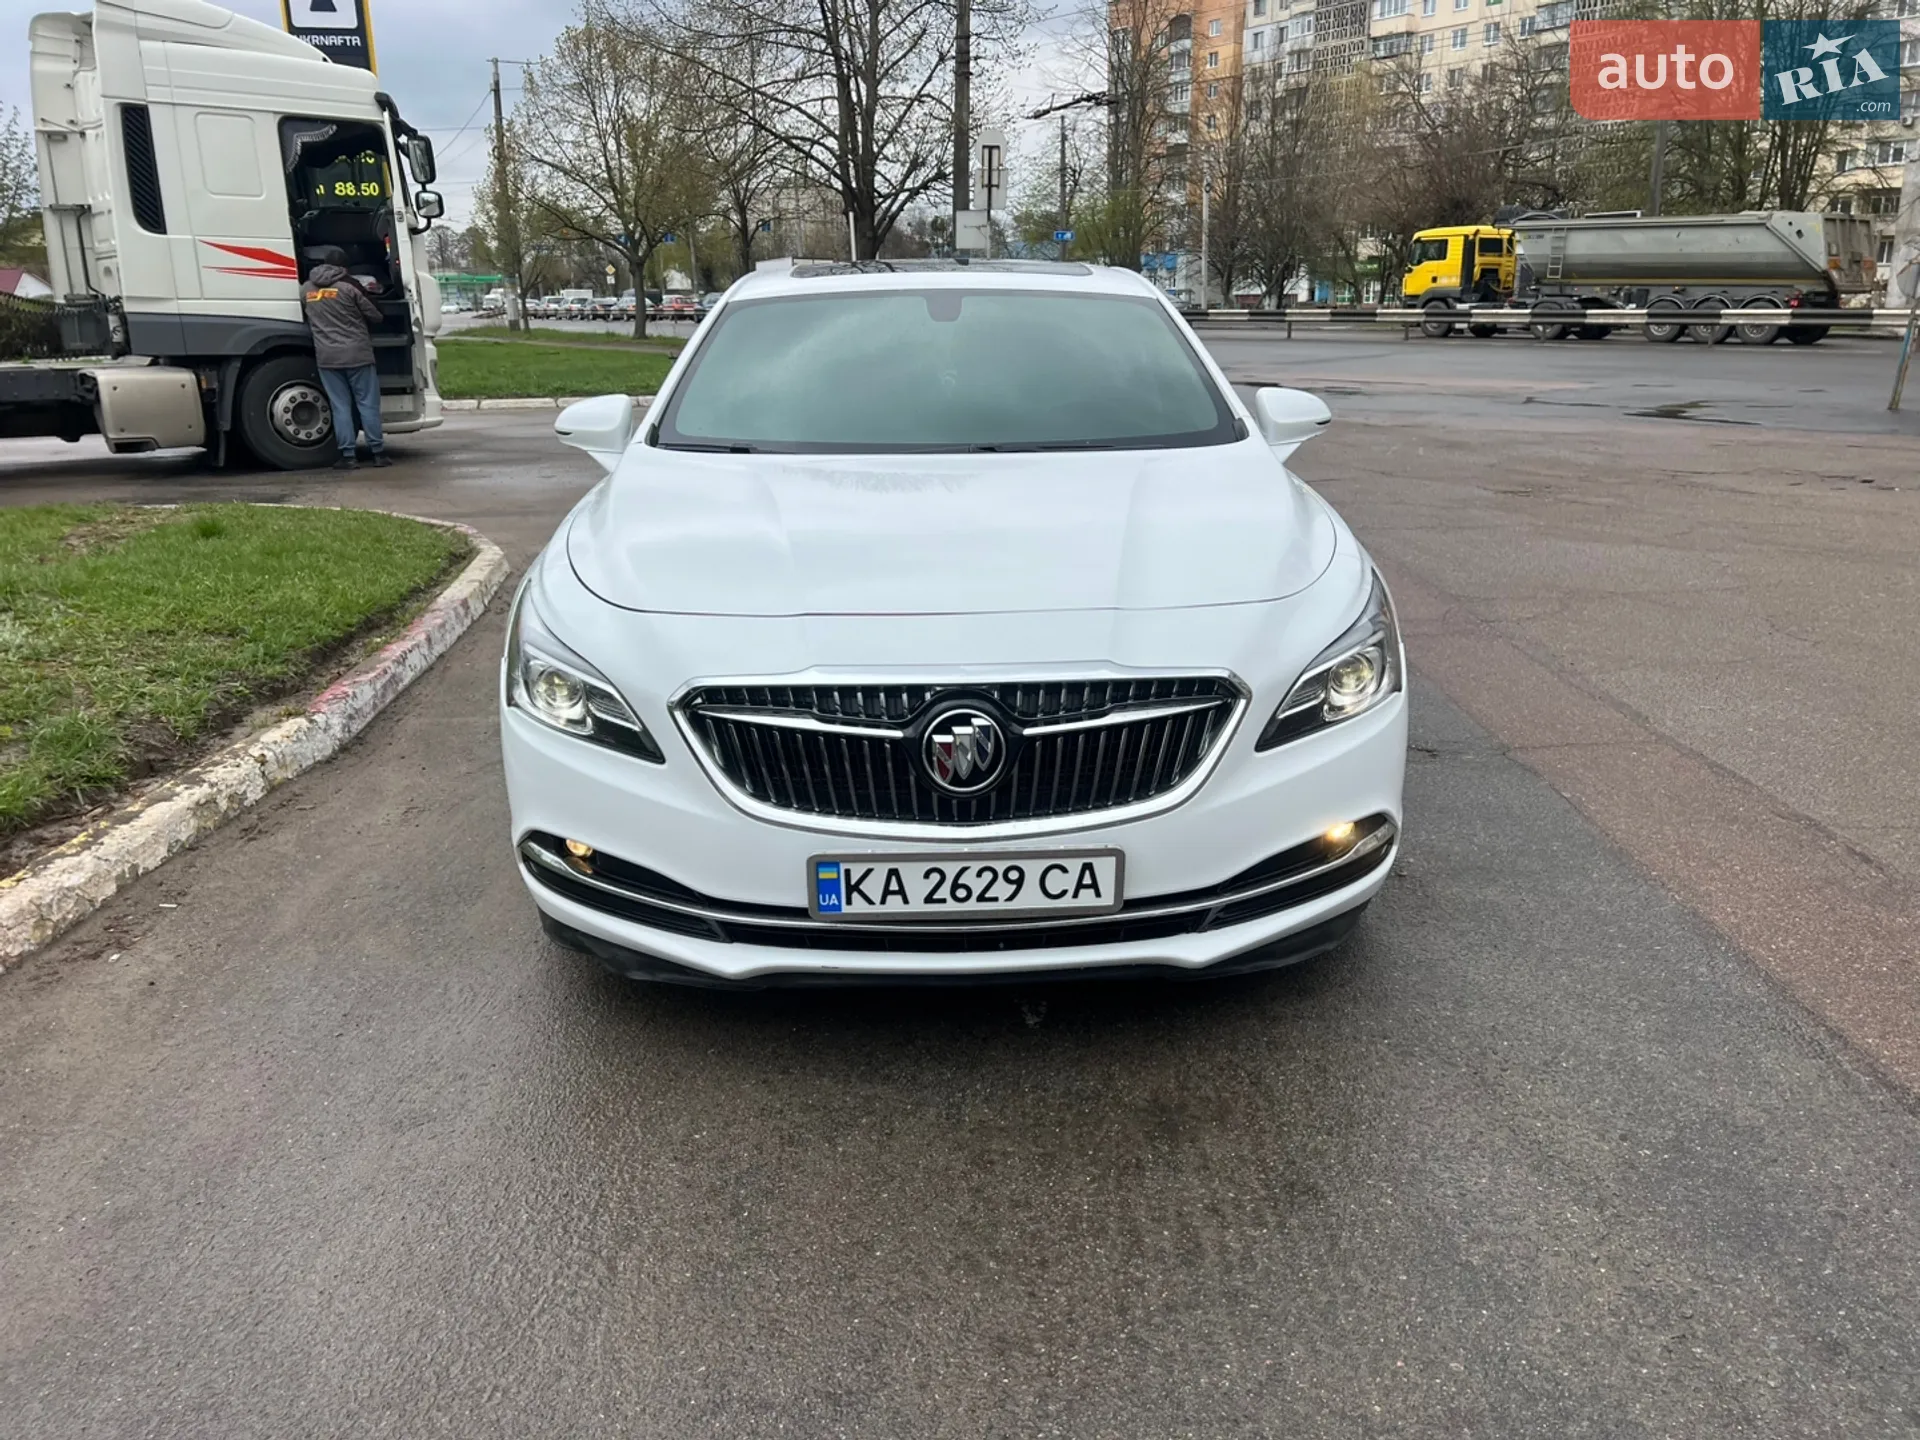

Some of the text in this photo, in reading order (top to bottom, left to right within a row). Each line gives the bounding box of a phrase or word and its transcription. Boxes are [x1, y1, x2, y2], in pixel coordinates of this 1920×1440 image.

[334, 181, 379, 196] 88.50
[844, 862, 1102, 906] KA 2629 CA
[819, 893, 839, 906] UA
